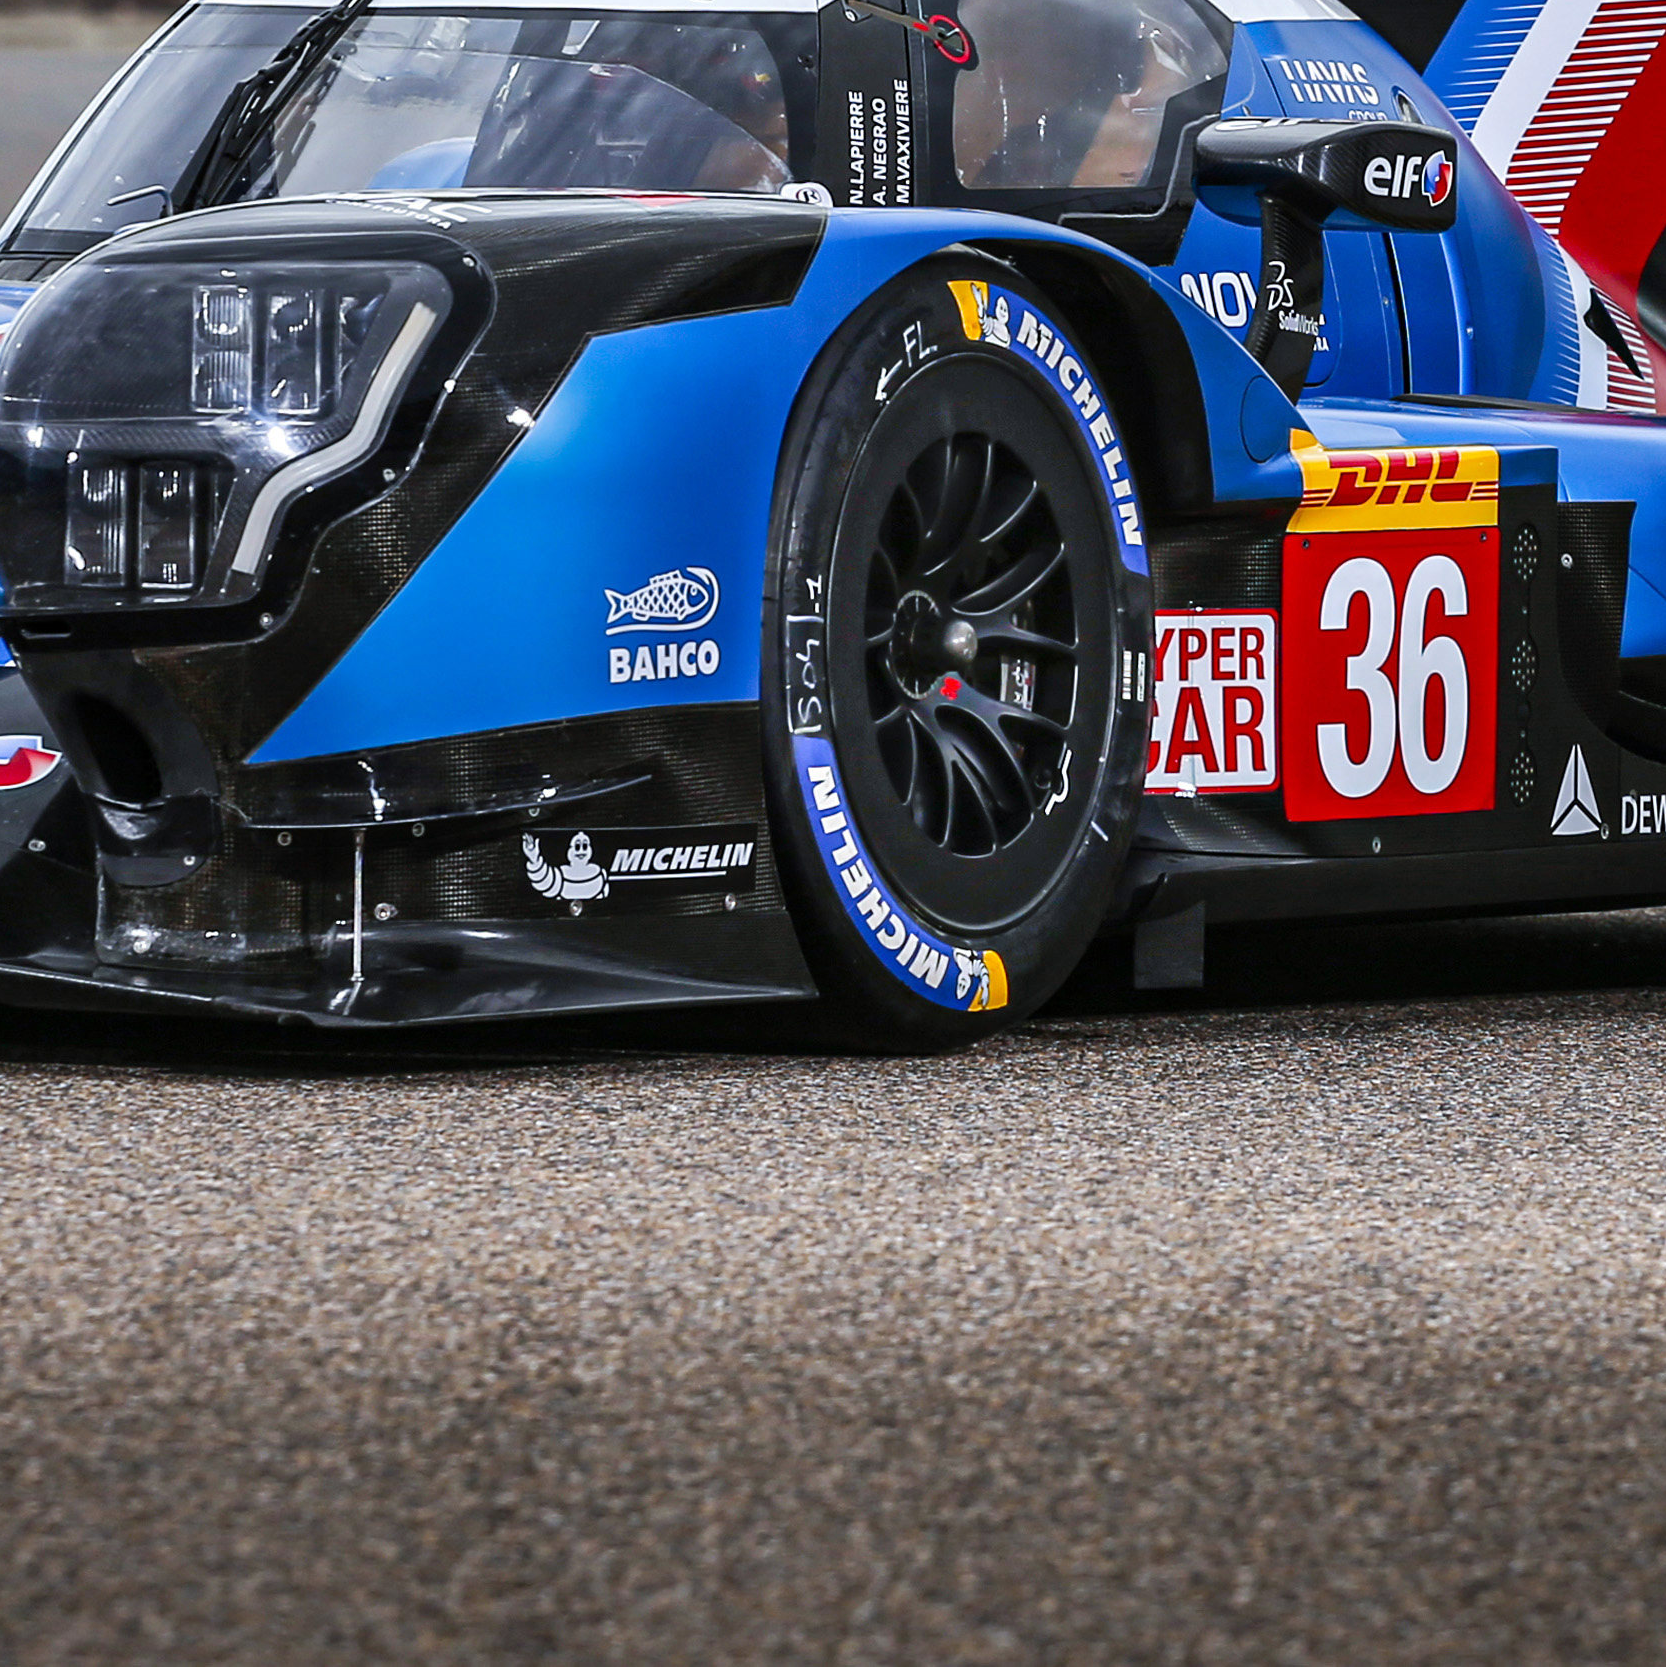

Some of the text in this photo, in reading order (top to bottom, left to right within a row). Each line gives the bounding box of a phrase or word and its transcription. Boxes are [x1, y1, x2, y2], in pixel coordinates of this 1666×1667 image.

[1279, 59, 1381, 106] HAVAS
[848, 91, 865, 205] N.LAPIERRE
[871, 97, 887, 206] A. NEGRAO
[893, 79, 910, 204] M.VAXIVIERE
[1364, 155, 1423, 198] elf
[1015, 309, 1143, 547] MICHELIN
[1328, 451, 1475, 504] DHL
[609, 640, 720, 683] BAHCO
[1155, 626, 1266, 682] YPER
[1317, 556, 1468, 799] 36
[1147, 686, 1268, 774] AR
[610, 842, 754, 874] MICHELIN
[808, 765, 950, 989] MICHELIN
